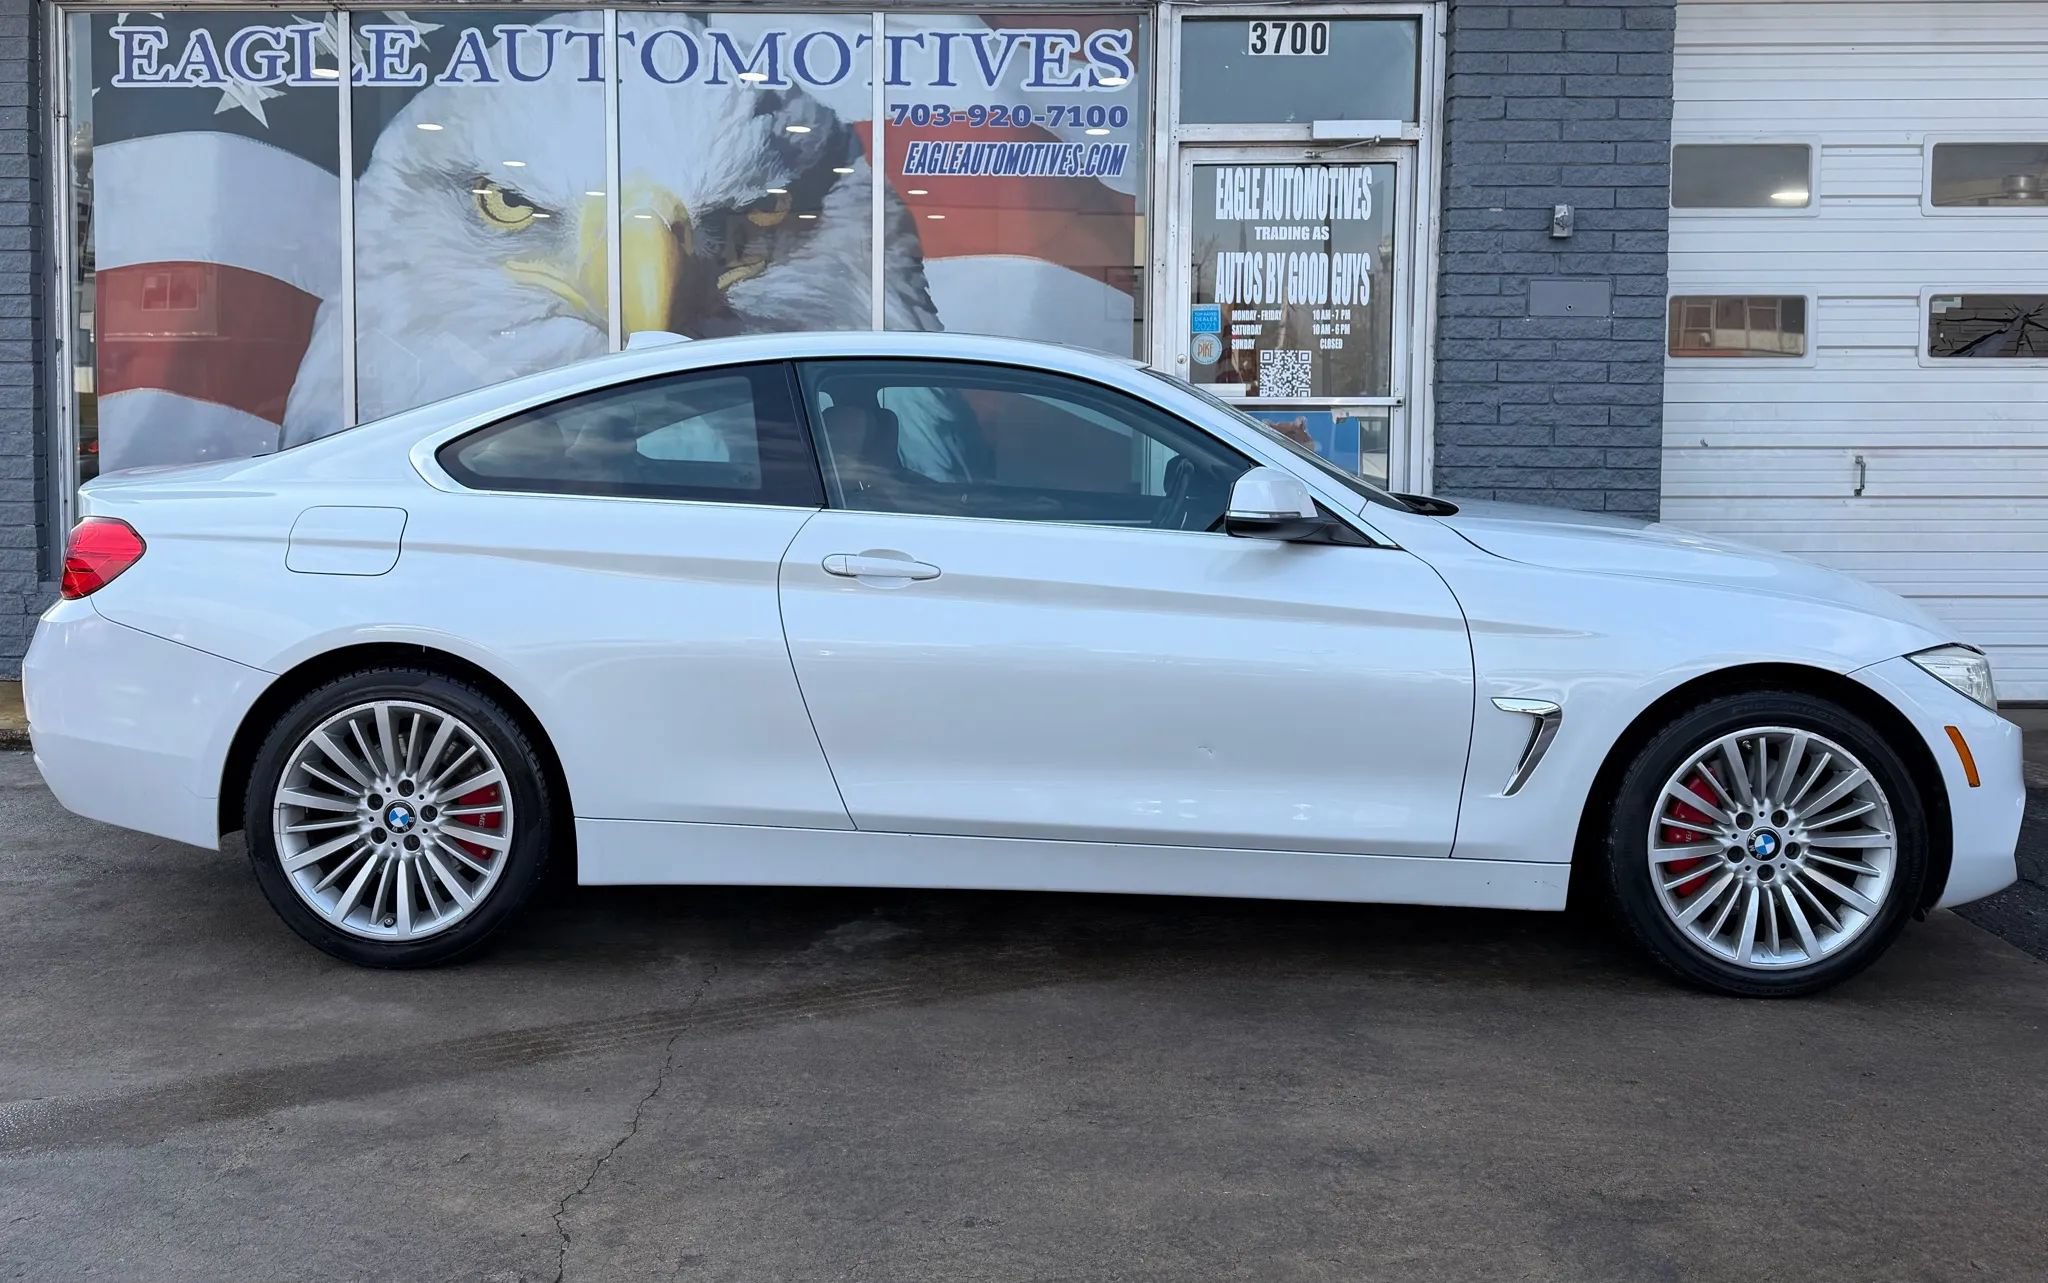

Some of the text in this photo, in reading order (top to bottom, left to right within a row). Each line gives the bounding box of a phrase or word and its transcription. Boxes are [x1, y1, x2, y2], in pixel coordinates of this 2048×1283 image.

[1250, 22, 1328, 54] 3700
[111, 25, 1135, 91] EAGLE AUTOMOTIVES
[889, 103, 1130, 129] 703-920-7100
[901, 142, 1130, 178] EAGLEAUTOMOTIVES.COM
[1215, 166, 1373, 222] EAGLE AUTOMOTIVES
[1254, 226, 1330, 241] TRADING AS
[1214, 251, 1371, 306] AUTOS BY GOOD GUYS
[1231, 310, 1257, 321] MONDAY
[1261, 310, 1283, 321] FRIDAY
[1312, 309, 1320, 320] 10
[1320, 309, 1331, 320] AM
[1341, 309, 1351, 320] PM
[1231, 324, 1263, 336] SATURDAY
[1312, 324, 1320, 335] 10
[1320, 324, 1331, 335] AM
[1341, 324, 1351, 335] PM
[1231, 338, 1343, 350] SUNDAY CLOSED
